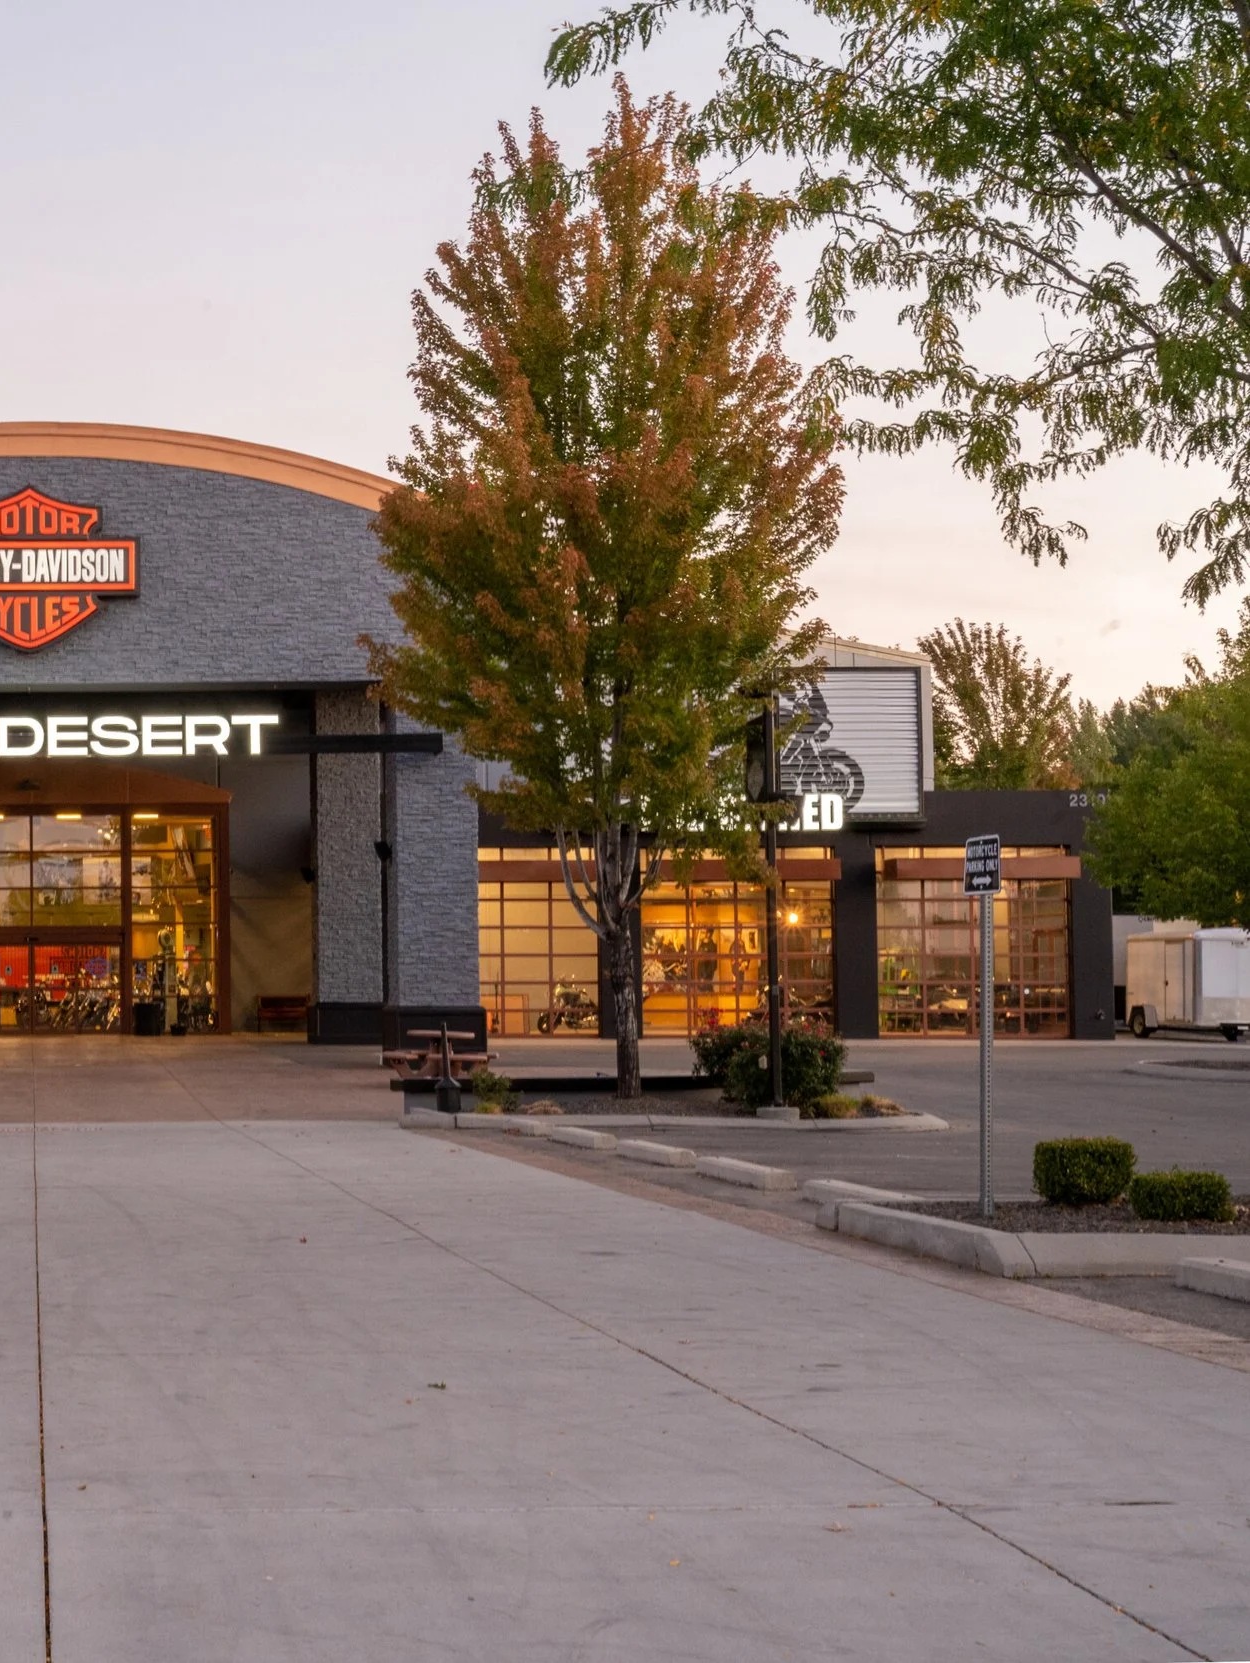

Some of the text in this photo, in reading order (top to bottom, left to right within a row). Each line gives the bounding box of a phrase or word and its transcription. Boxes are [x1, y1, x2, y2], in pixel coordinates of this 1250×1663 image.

[968, 843, 997, 859] MOTORCYCLE
[966, 859, 998, 872] PARKING ONLY
